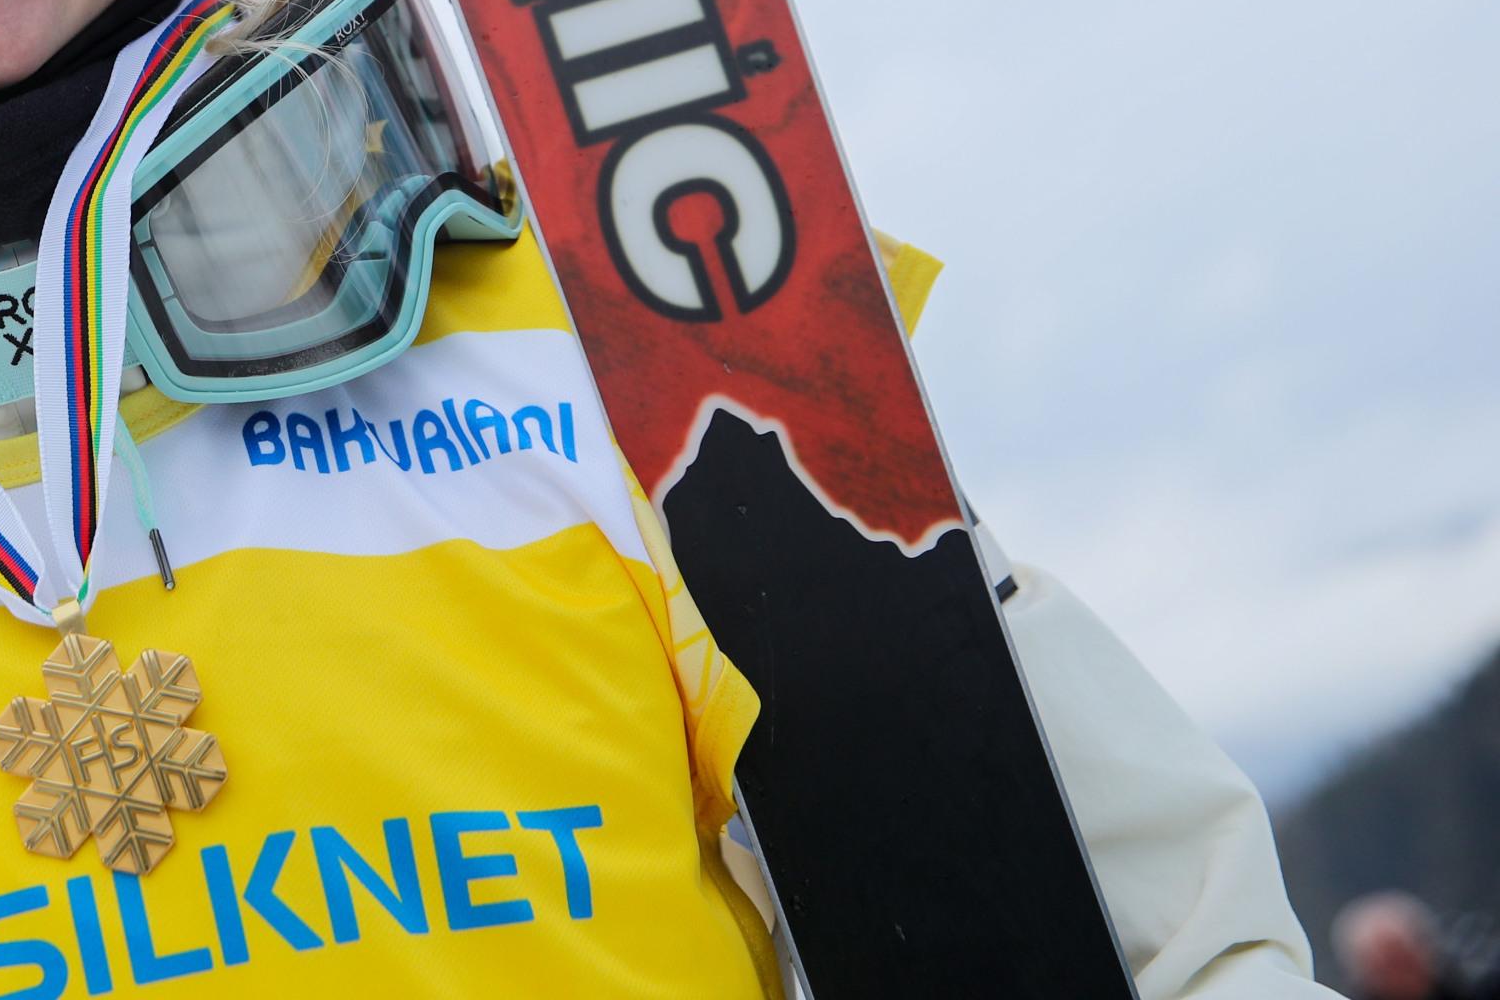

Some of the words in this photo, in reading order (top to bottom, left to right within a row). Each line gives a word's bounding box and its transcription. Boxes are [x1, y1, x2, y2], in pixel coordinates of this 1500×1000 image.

[334, 9, 366, 43] ROXY
[242, 398, 579, 475] BAKURIANI
[70, 714, 142, 791] FIS
